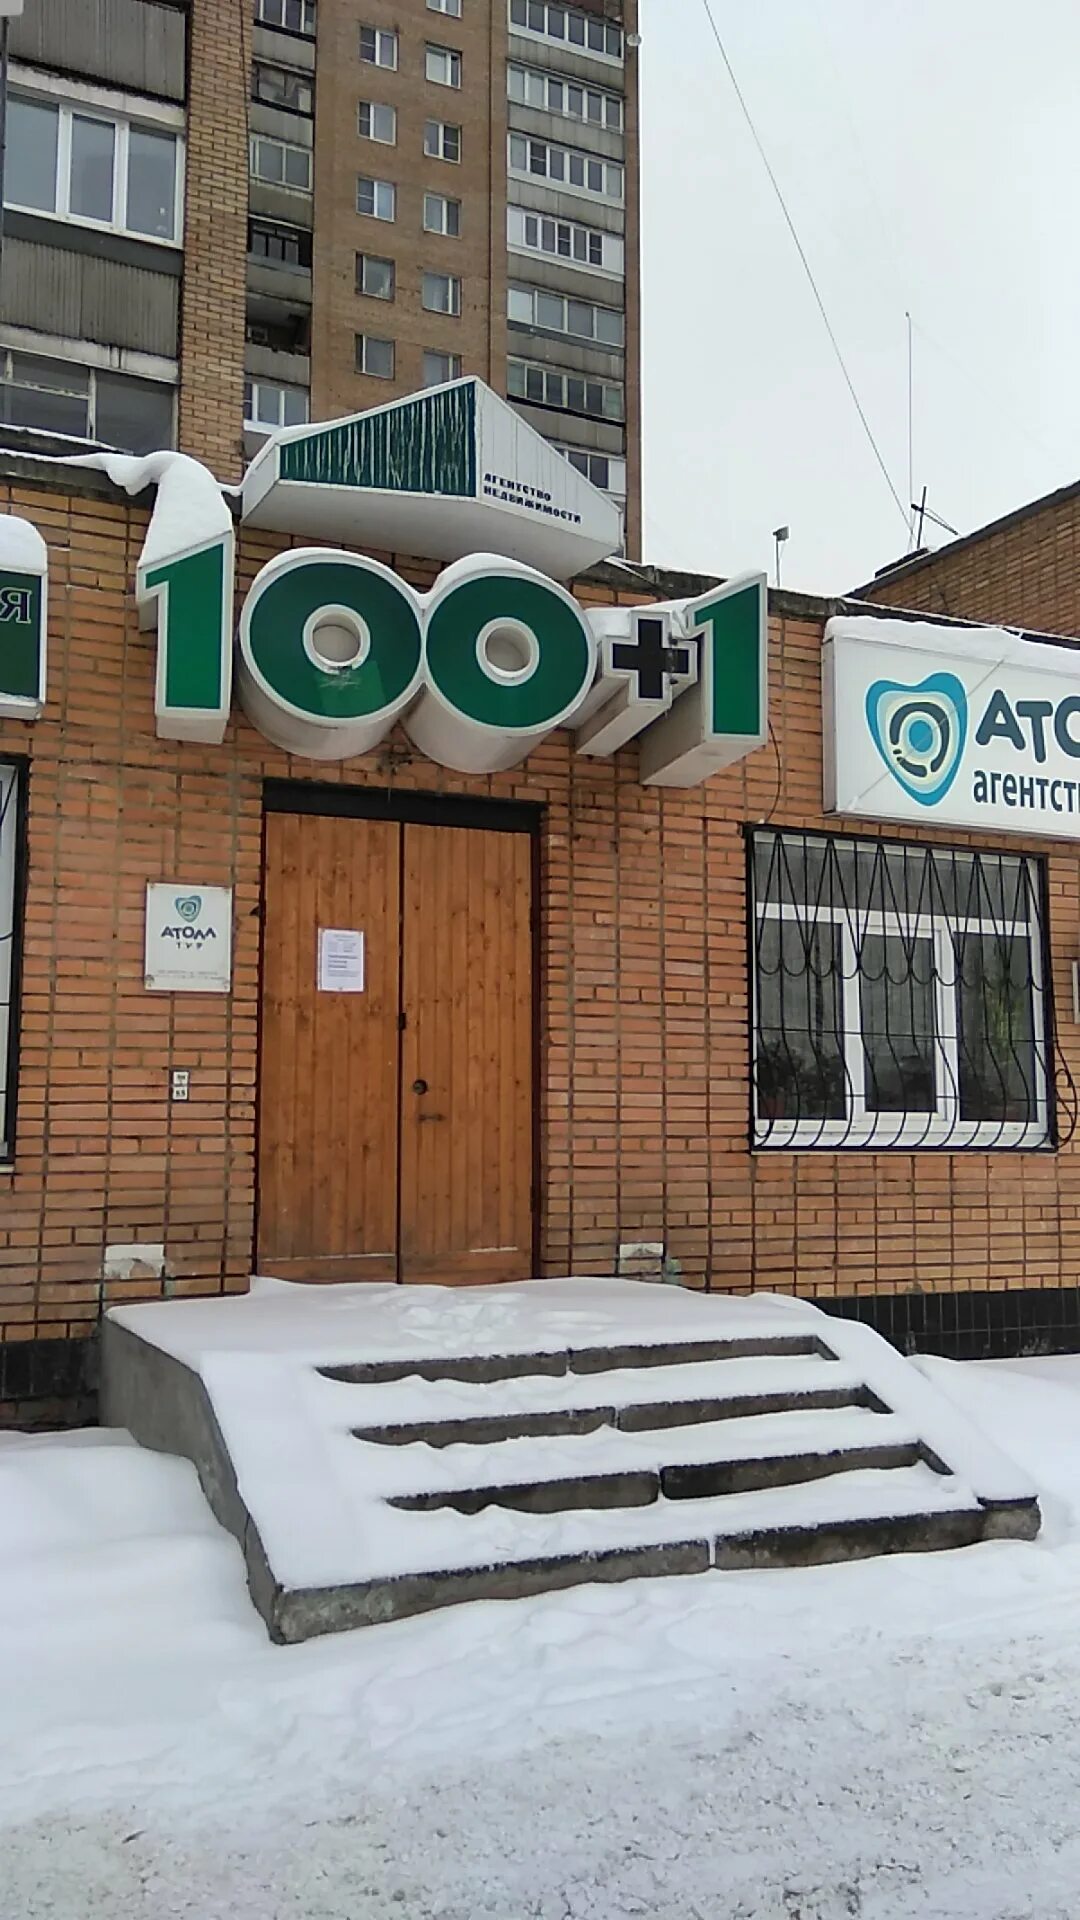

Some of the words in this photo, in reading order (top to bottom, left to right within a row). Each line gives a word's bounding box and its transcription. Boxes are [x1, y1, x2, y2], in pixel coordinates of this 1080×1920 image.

[483, 486, 582, 524] НЕДВИЖИМОСТИ
[484, 473, 552, 502] АГЕНТСТВО
[139, 535, 766, 740] 100+1
[974, 770, 1080, 814] агентст
[161, 926, 217, 940] АТОЛЛ
